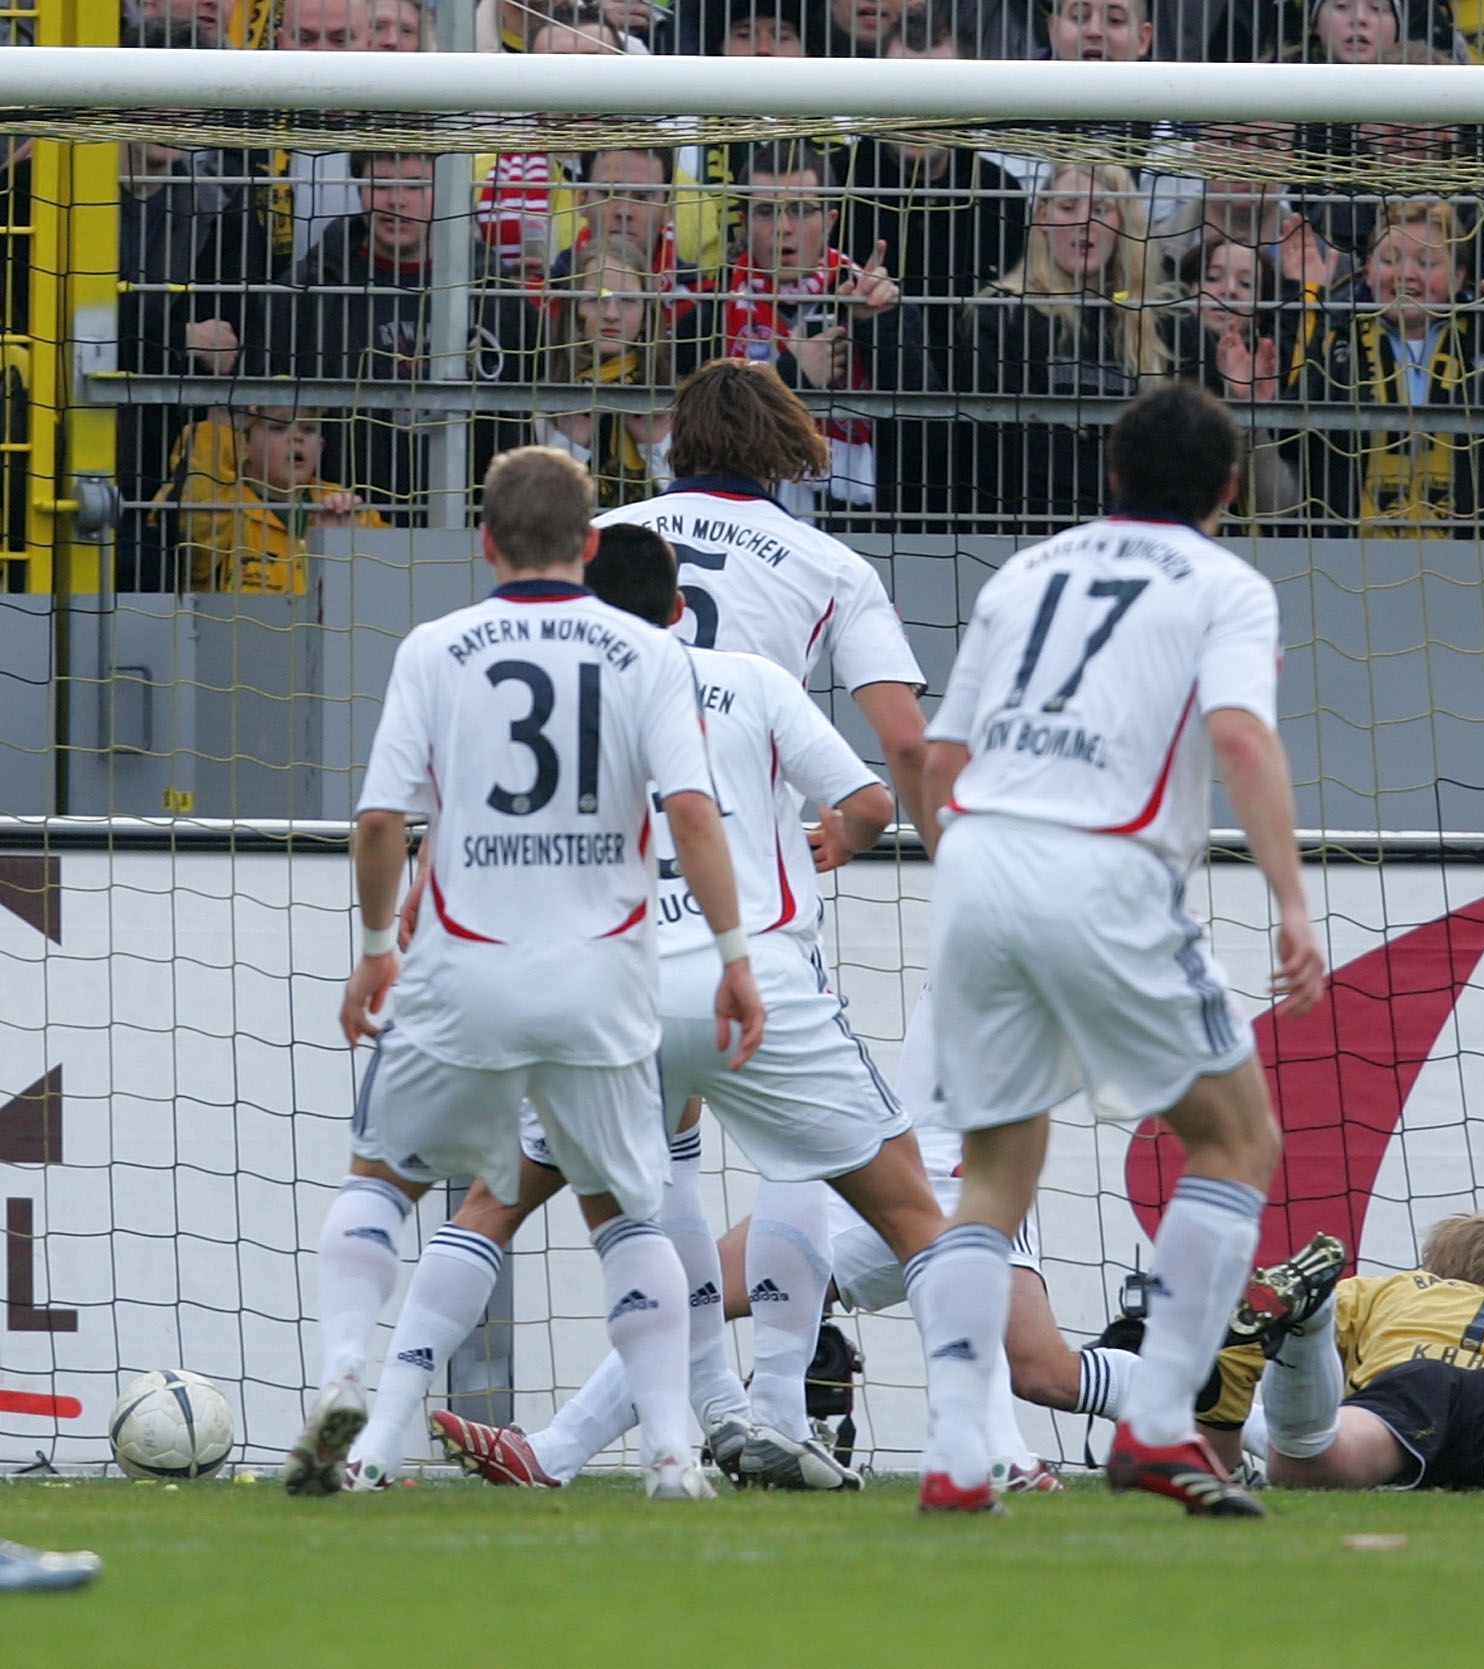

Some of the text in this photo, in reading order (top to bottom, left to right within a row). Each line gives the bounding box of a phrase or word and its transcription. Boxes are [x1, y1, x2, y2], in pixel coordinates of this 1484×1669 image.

[692, 517, 791, 568] MÜNCHEN
[448, 617, 640, 672] BAYERN MÜNCHEN
[1004, 571, 1150, 713] 17
[484, 659, 600, 817] 31
[463, 833, 626, 868] SCHWEINSTEIGER
